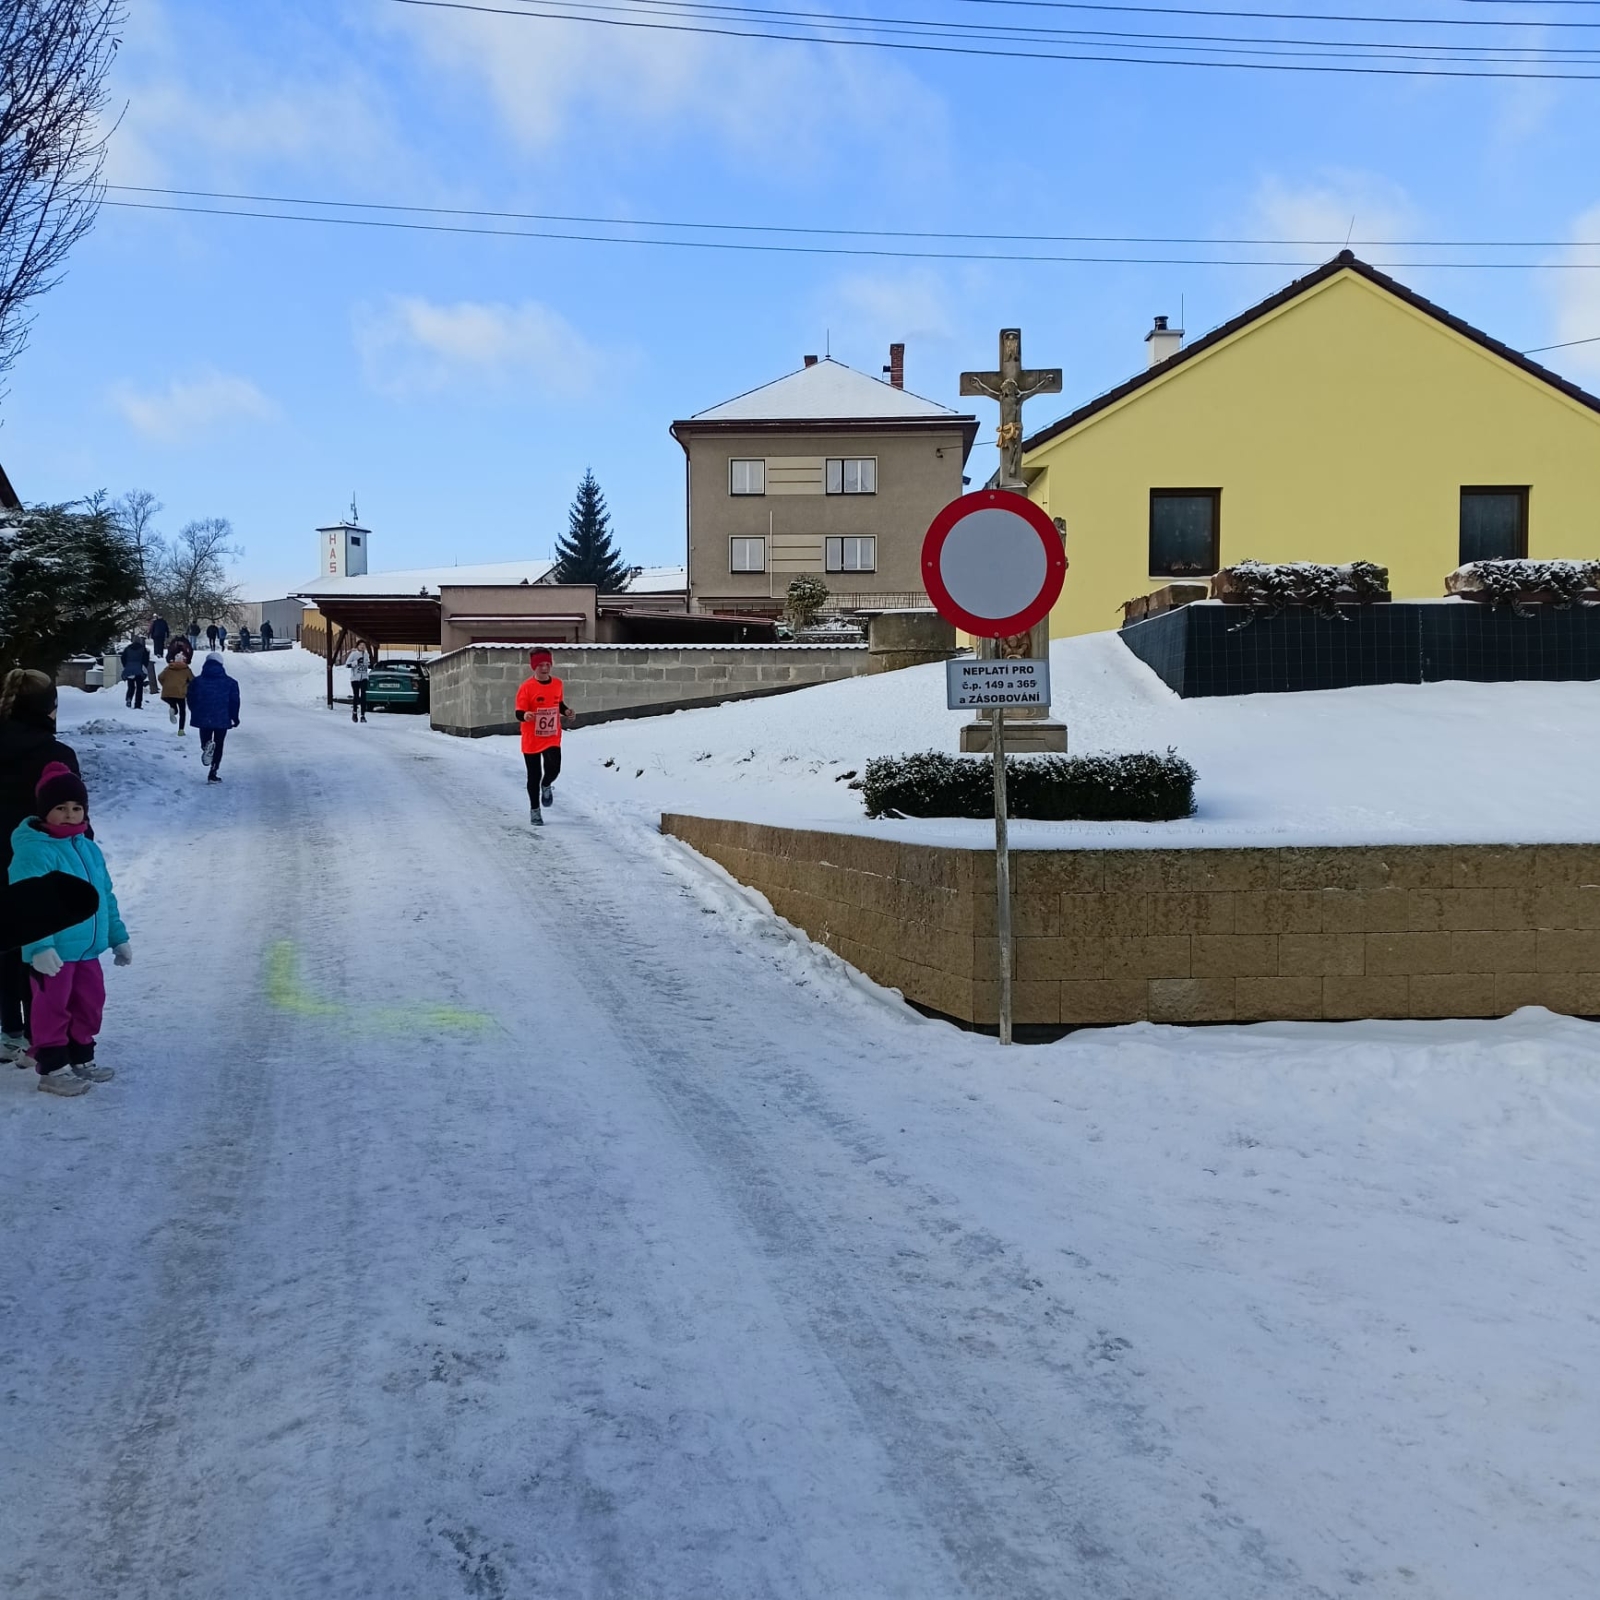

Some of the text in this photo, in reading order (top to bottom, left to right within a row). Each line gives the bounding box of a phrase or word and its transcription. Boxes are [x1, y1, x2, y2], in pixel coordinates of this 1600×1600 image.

[329, 533, 337, 573] HAS
[963, 665, 1034, 675] NEPLATÍ PRO
[962, 681, 982, 691] č.p.
[985, 680, 1004, 689] 149
[1017, 679, 1036, 688] 365
[969, 692, 1040, 703] ZÁSOBOVÁNÍ
[539, 717, 554, 729] 64
